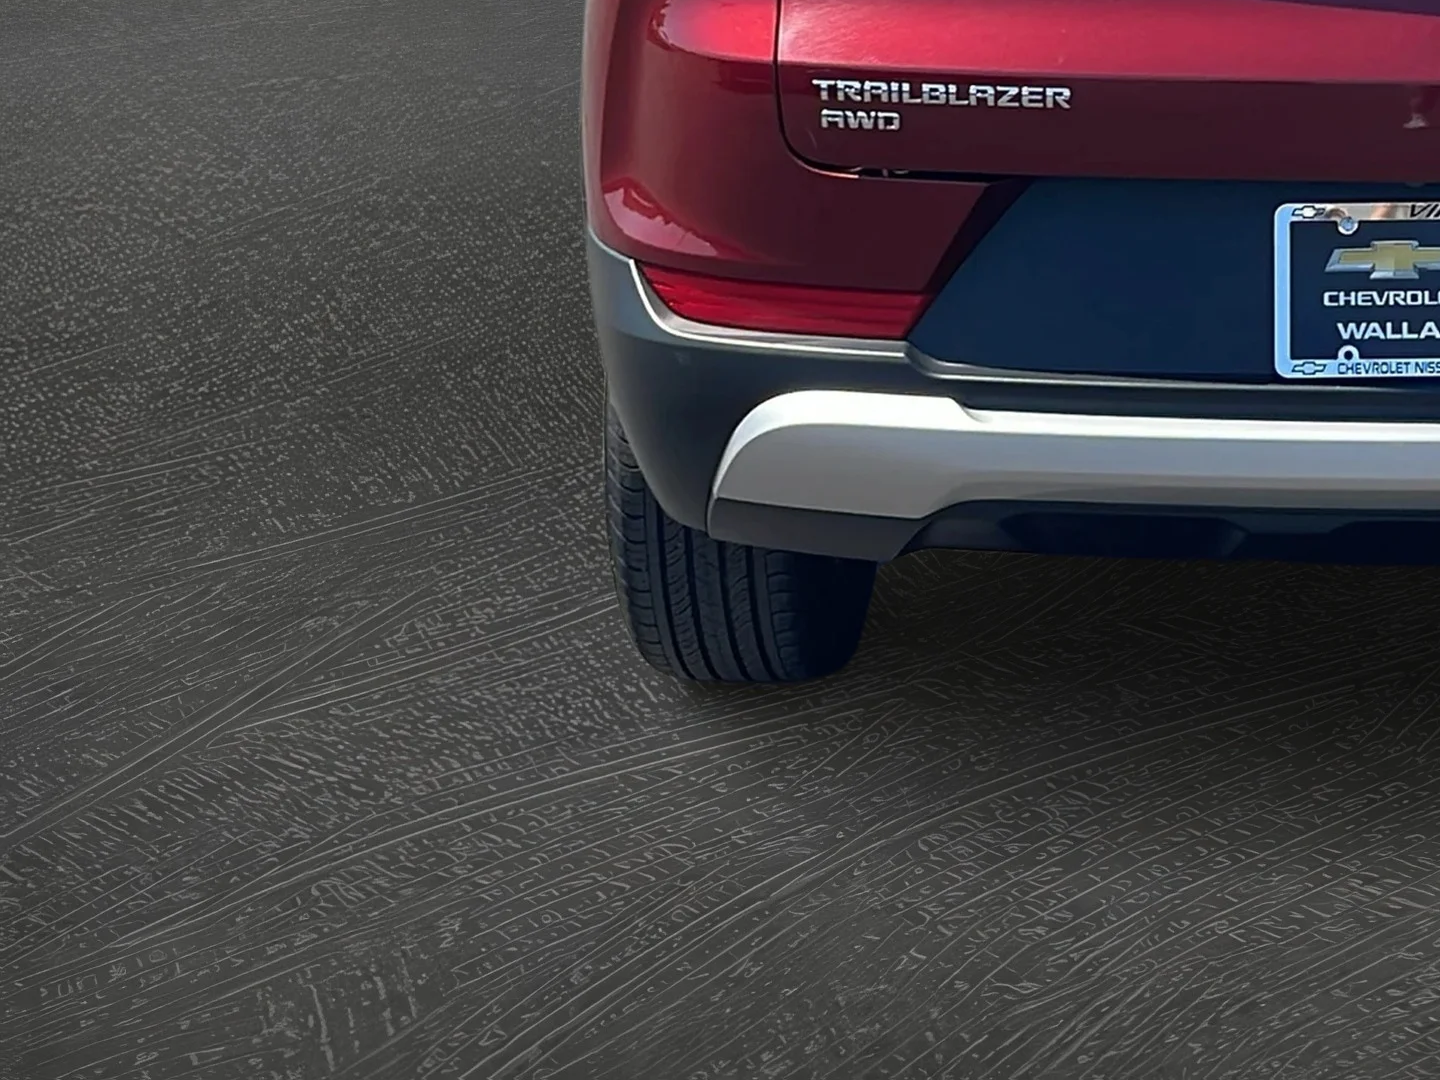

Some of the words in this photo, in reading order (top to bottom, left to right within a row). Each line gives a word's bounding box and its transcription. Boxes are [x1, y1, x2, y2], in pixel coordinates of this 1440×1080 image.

[812, 78, 1071, 109] TRAILBLAZER
[820, 108, 900, 130] AWD
[1337, 361, 1410, 375] CHEVROLET
